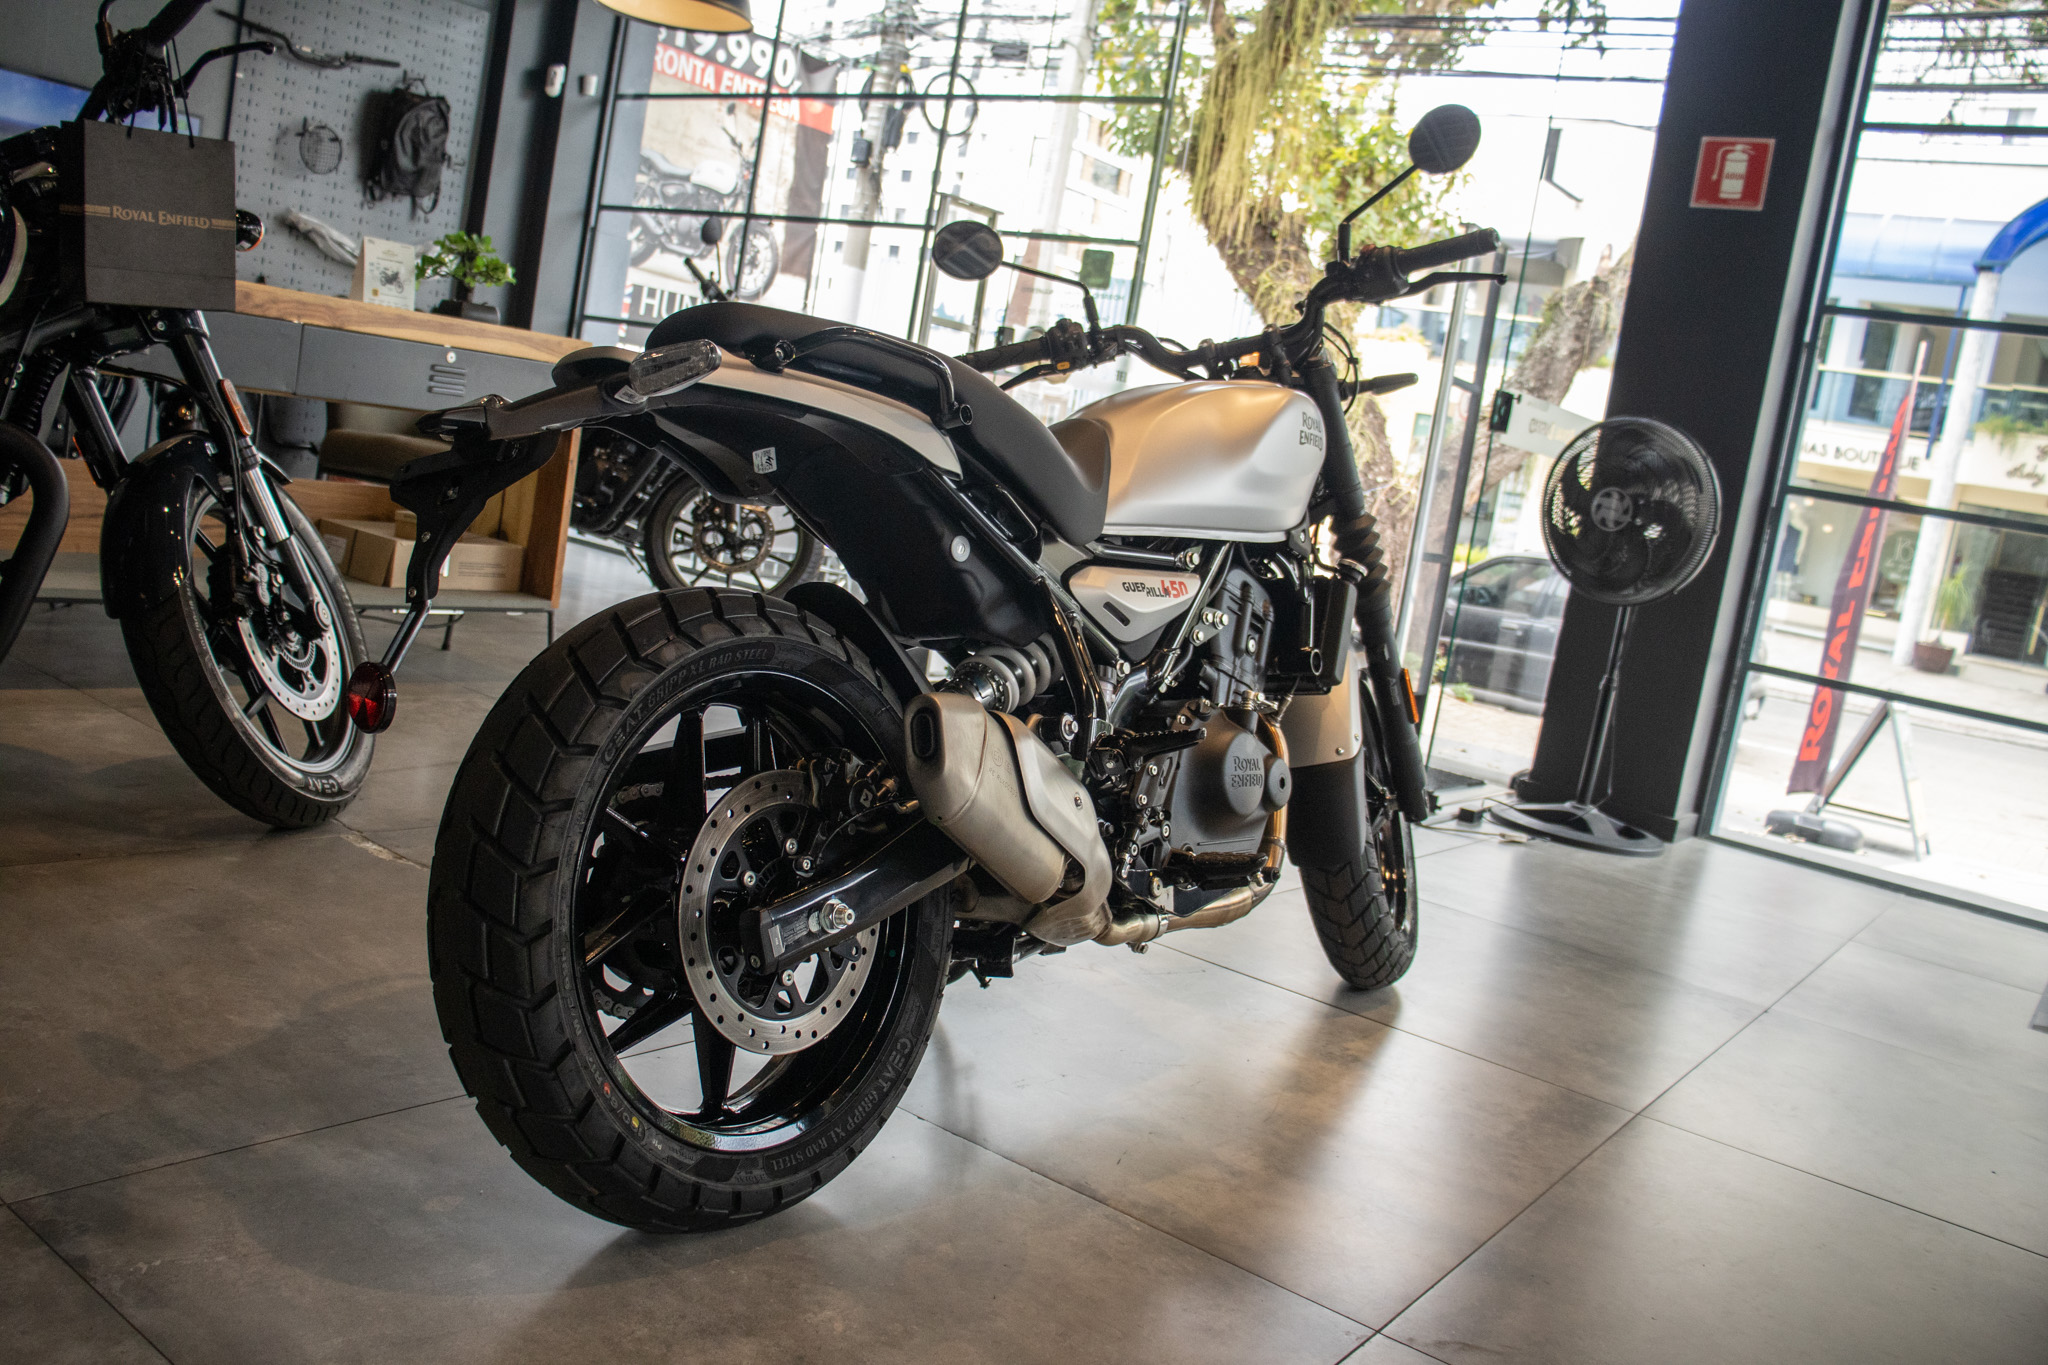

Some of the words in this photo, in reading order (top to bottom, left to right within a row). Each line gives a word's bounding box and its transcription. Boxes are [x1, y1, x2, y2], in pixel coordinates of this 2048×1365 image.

[112, 206, 155, 223] ROYAL
[158, 211, 209, 230] ENFIELD
[1302, 411, 1322, 433] ROYAL
[1299, 430, 1324, 452] ENFIELD
[1122, 581, 1170, 598] GUERRILLA
[1799, 601, 1856, 762] ROYAL
[602, 704, 645, 764] CEAT
[647, 670, 687, 708] GRIPP
[708, 652, 733, 668] RAD
[735, 648, 769, 662] STEEL
[1232, 755, 1261, 773] ROYAL
[307, 776, 339, 794] CEAT
[1230, 773, 1264, 790] ENFIELD
[879, 1037, 913, 1092] CEAT
[846, 1091, 879, 1130] GRIPP
[830, 1127, 848, 1143] XL
[805, 1137, 828, 1158] RAD
[770, 1153, 804, 1171] STEEL
